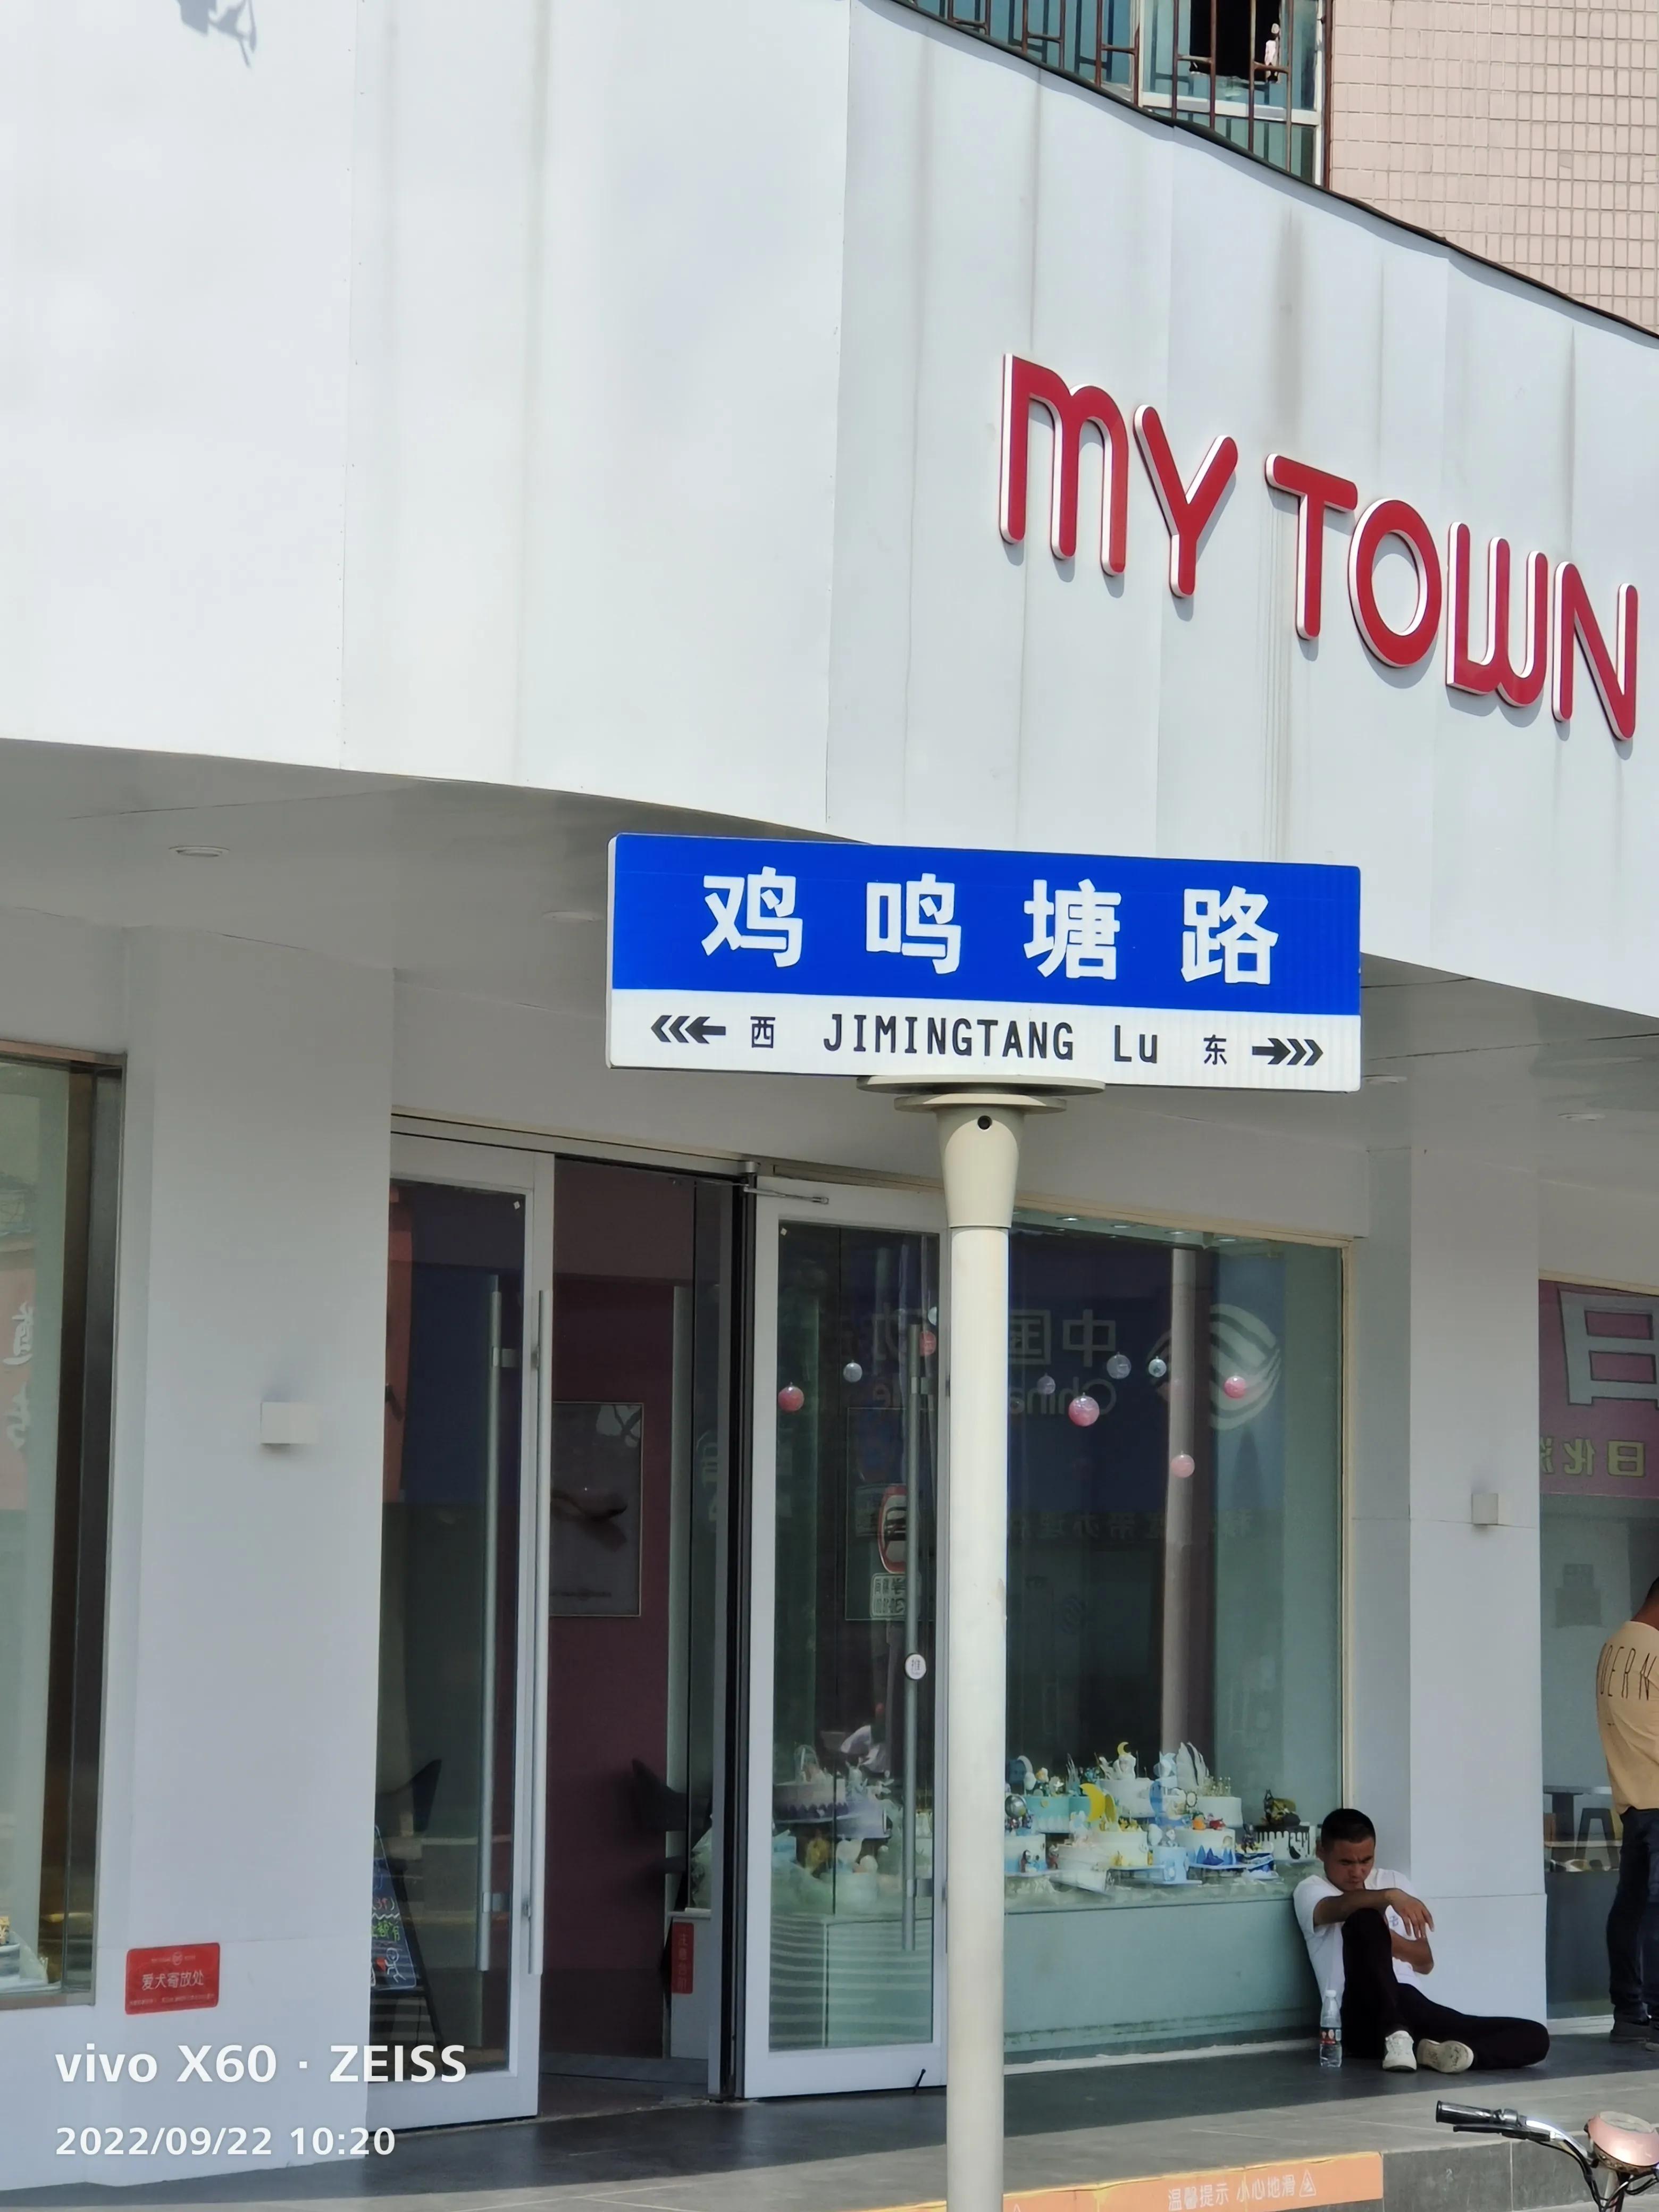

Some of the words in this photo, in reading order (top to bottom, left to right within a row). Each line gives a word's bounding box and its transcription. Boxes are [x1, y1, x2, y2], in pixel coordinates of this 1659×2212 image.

[1265, 453, 1639, 741] TOWN
[701, 865, 1278, 986] 鸡鸣塘路
[750, 1016, 776, 1049] 西
[824, 1013, 1074, 1061] JIMINGTANG
[1114, 1024, 1158, 1064] Lu
[1203, 1034, 1228, 1066] 东
[1236, 2174, 1296, 2203] 小心地滑
